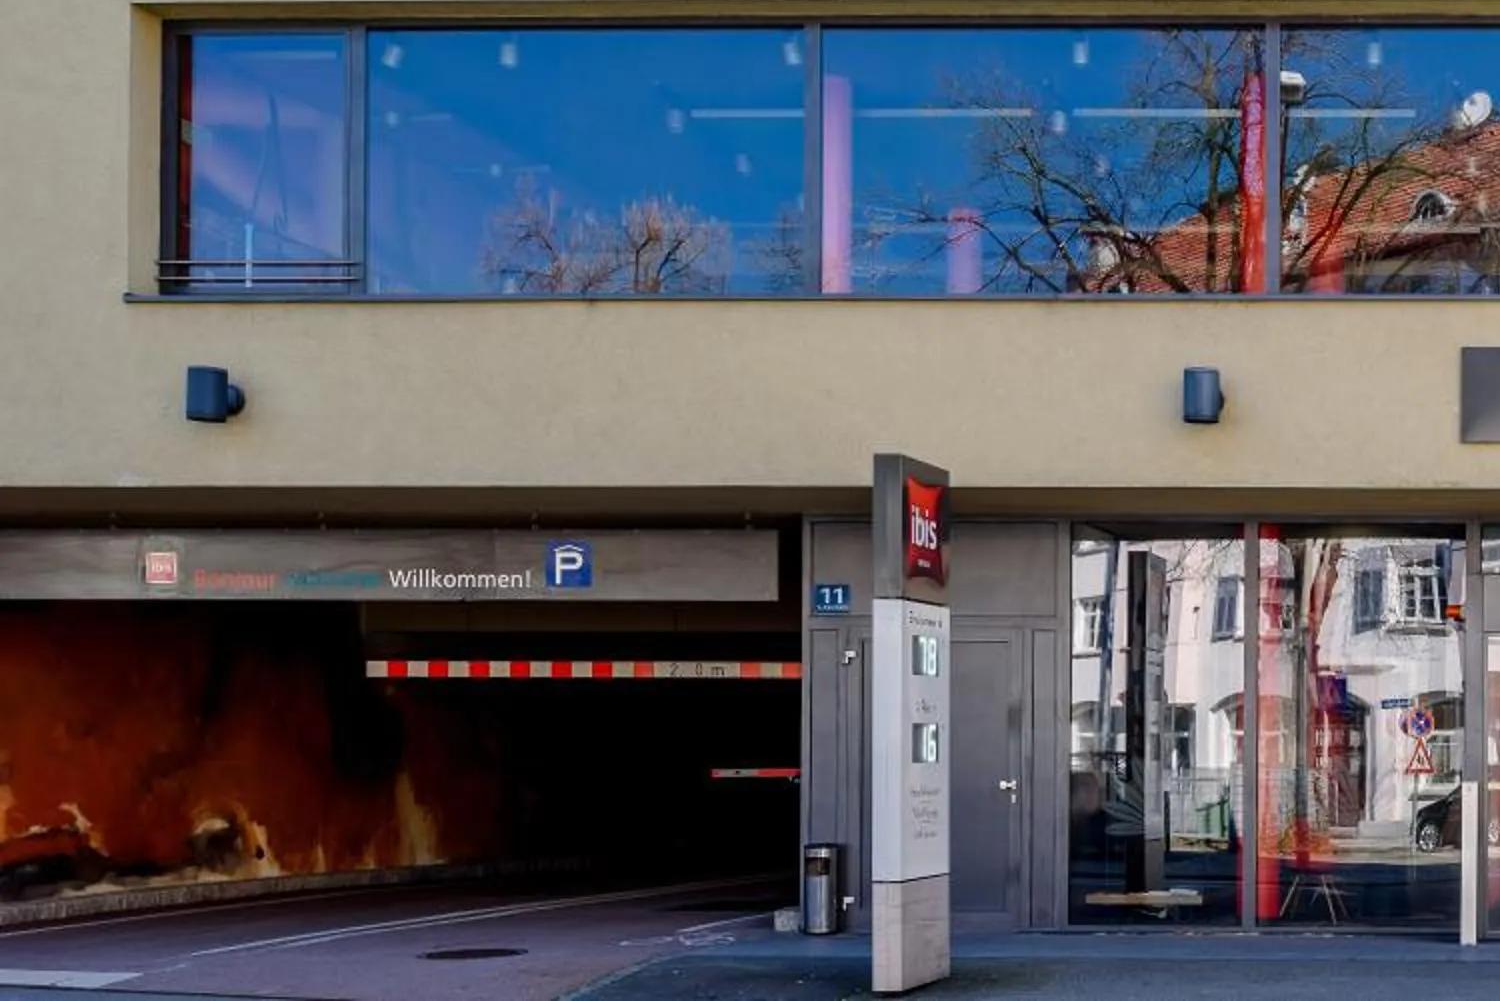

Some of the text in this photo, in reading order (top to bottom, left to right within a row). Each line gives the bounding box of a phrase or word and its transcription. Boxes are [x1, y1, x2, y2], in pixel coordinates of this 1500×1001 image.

[911, 502, 938, 551] ibis
[388, 568, 532, 588] Willkommen!
[555, 550, 584, 585] P
[820, 587, 844, 604] 11
